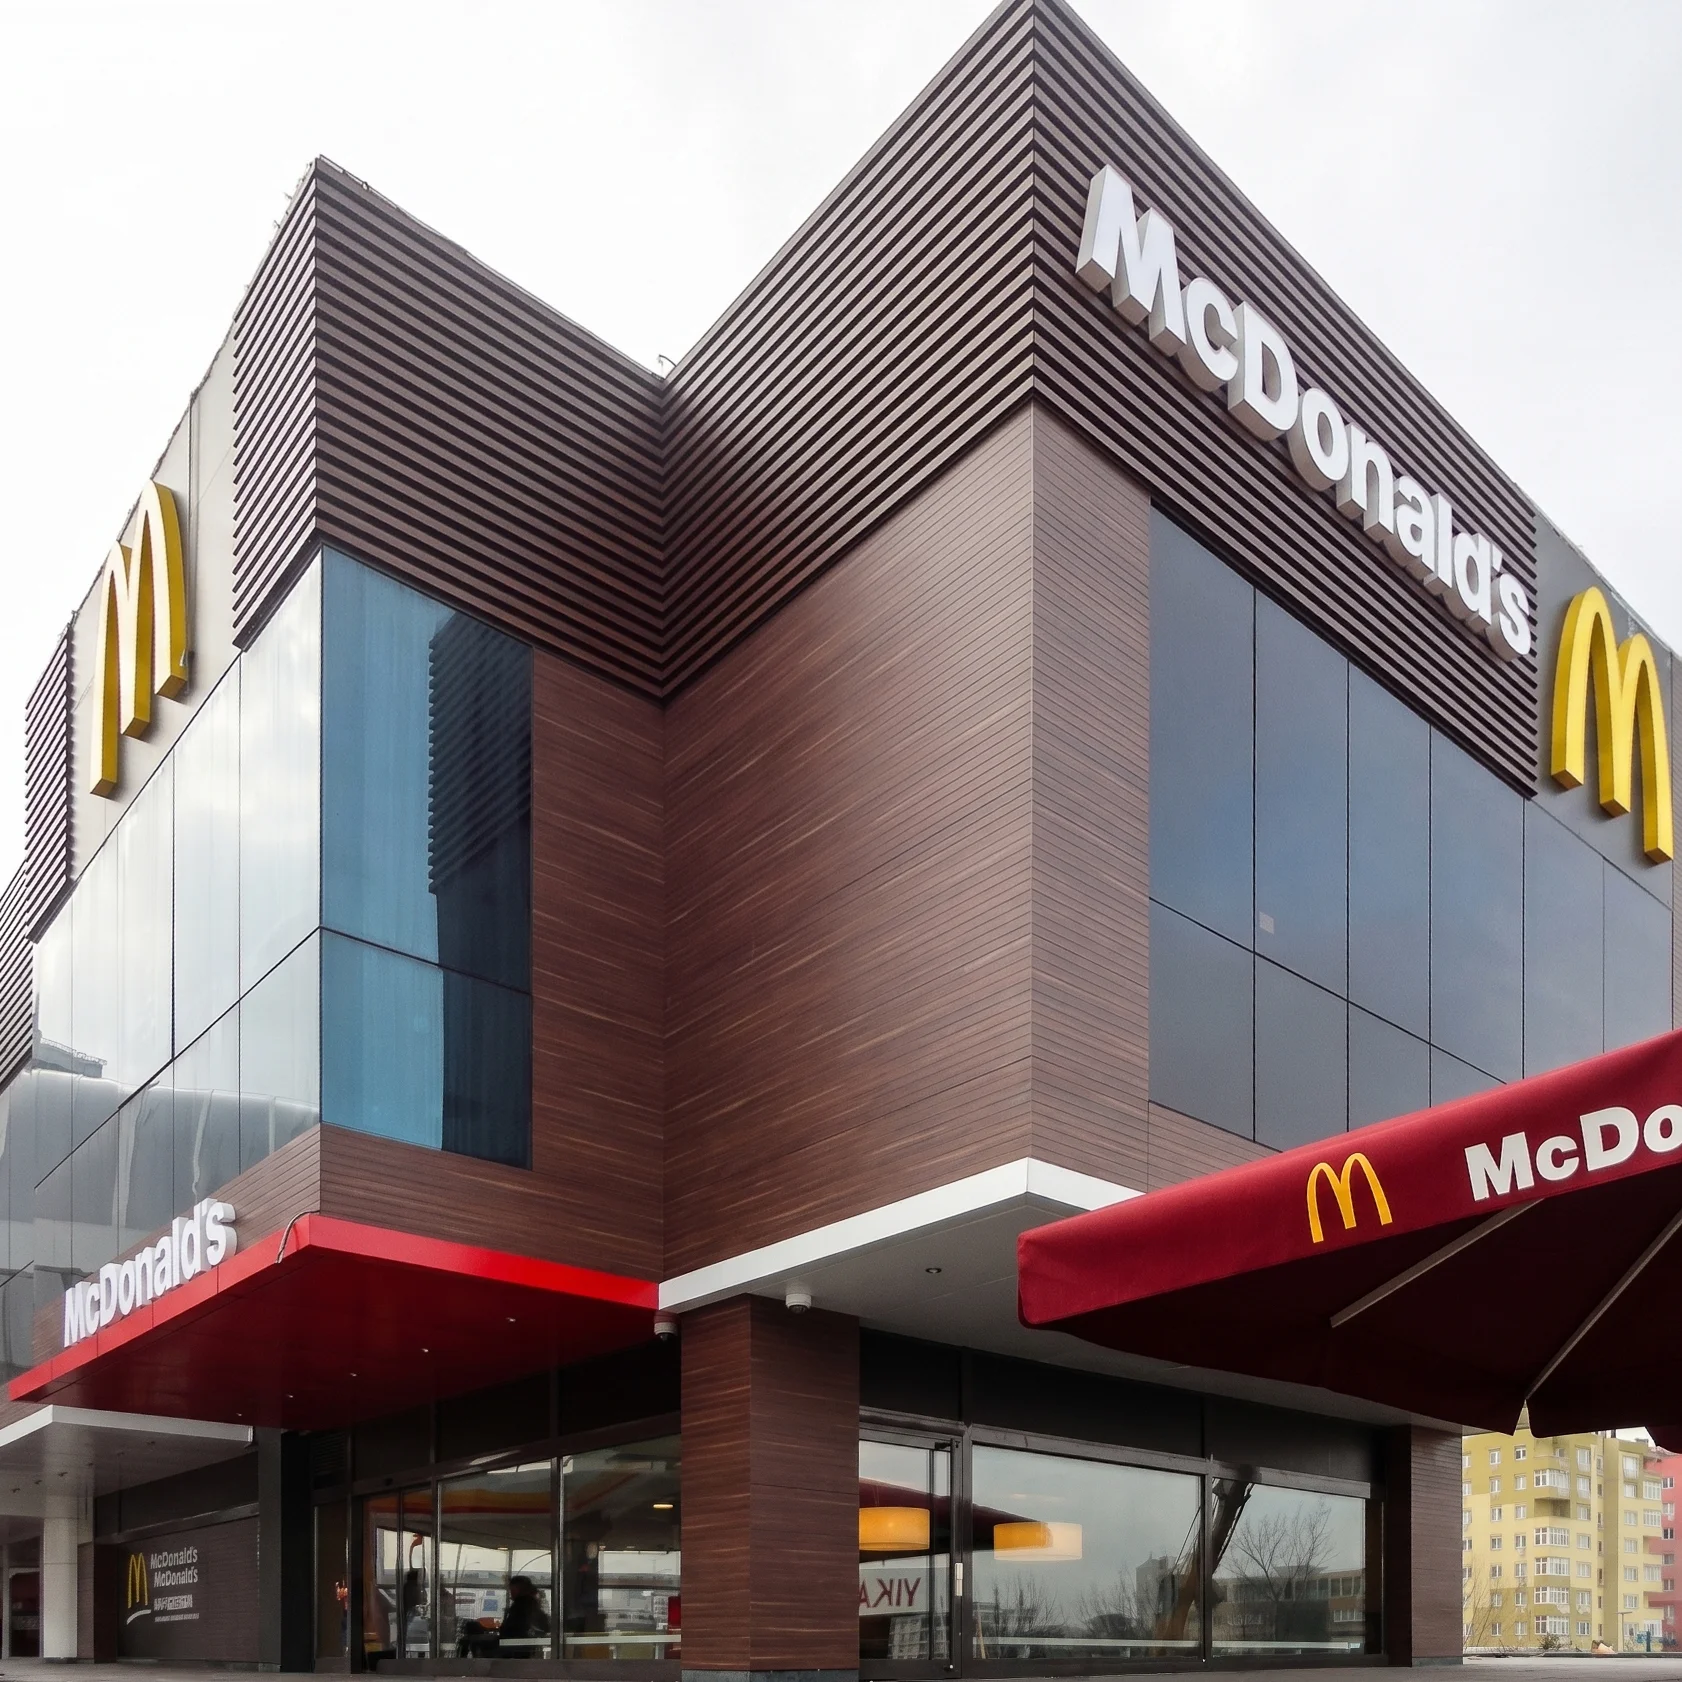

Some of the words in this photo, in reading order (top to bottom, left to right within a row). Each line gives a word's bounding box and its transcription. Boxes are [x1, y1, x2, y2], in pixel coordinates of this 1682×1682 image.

[1076, 164, 1533, 662] McDonald's
[1464, 1104, 1682, 1202] McDo
[64, 1198, 238, 1348] McDonald's
[150, 1546, 198, 1569] McDonald's
[153, 1566, 199, 1588] McDonald's
